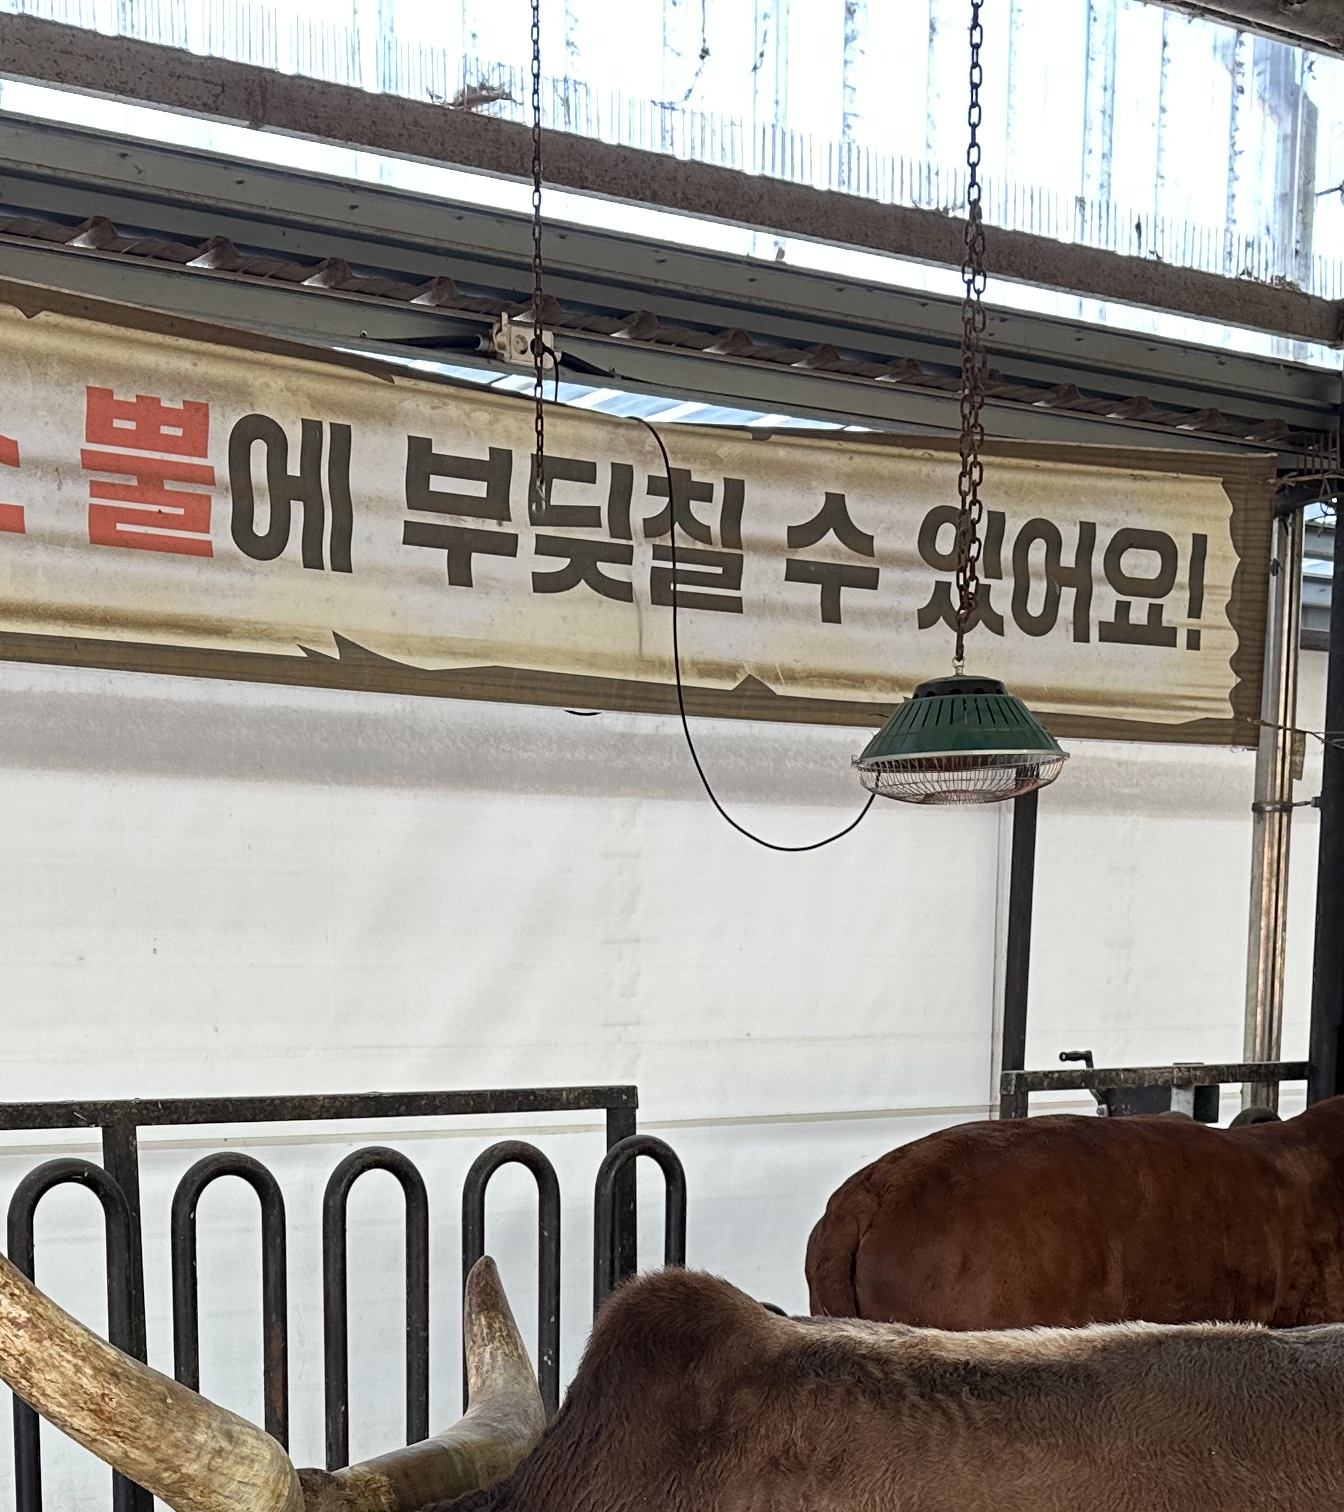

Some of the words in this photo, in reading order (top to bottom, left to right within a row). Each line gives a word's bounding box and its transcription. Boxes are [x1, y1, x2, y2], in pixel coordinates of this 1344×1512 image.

[80, 385, 354, 573] 뿔에
[402, 434, 745, 614] 부딪칠
[784, 491, 880, 624] 수
[917, 504, 1208, 651] 있어요!
